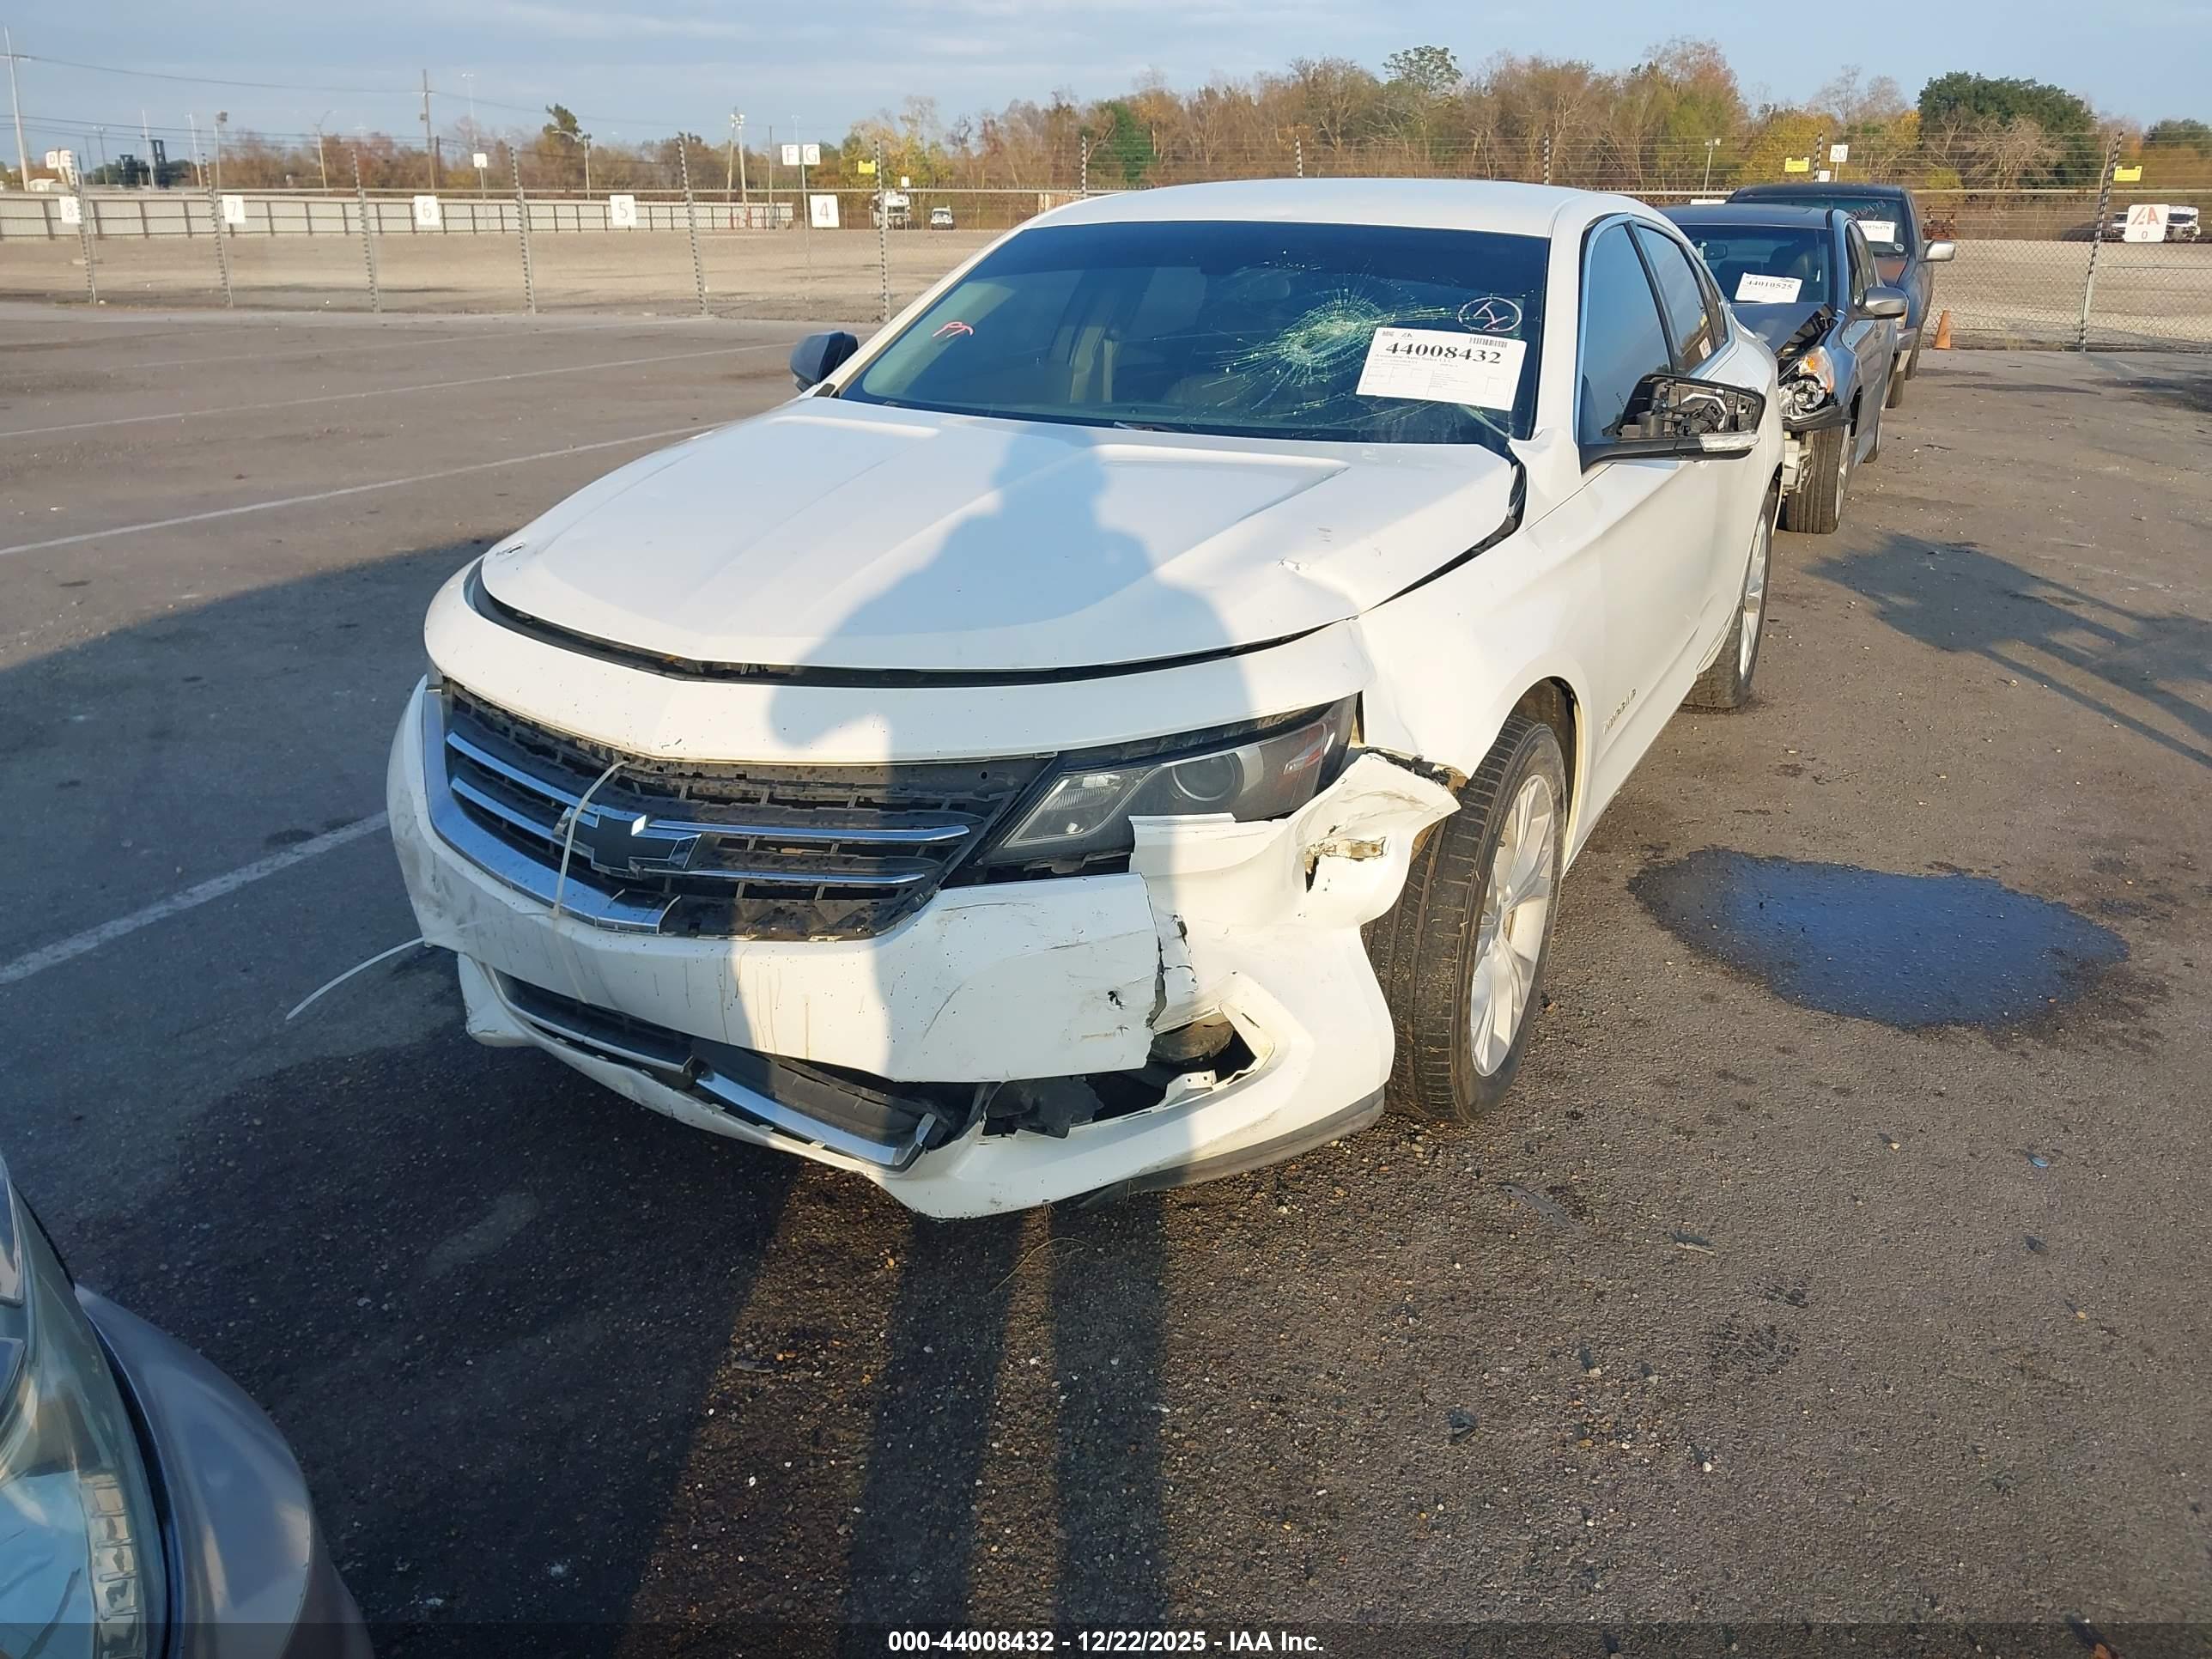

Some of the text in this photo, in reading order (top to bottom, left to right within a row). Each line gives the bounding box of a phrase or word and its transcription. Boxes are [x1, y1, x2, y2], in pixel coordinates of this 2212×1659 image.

[1832, 148, 1846, 159] 20
[422, 201, 433, 220] 6
[618, 201, 628, 219] 5
[819, 201, 830, 221] 4
[1385, 342, 1502, 365] 44008432
